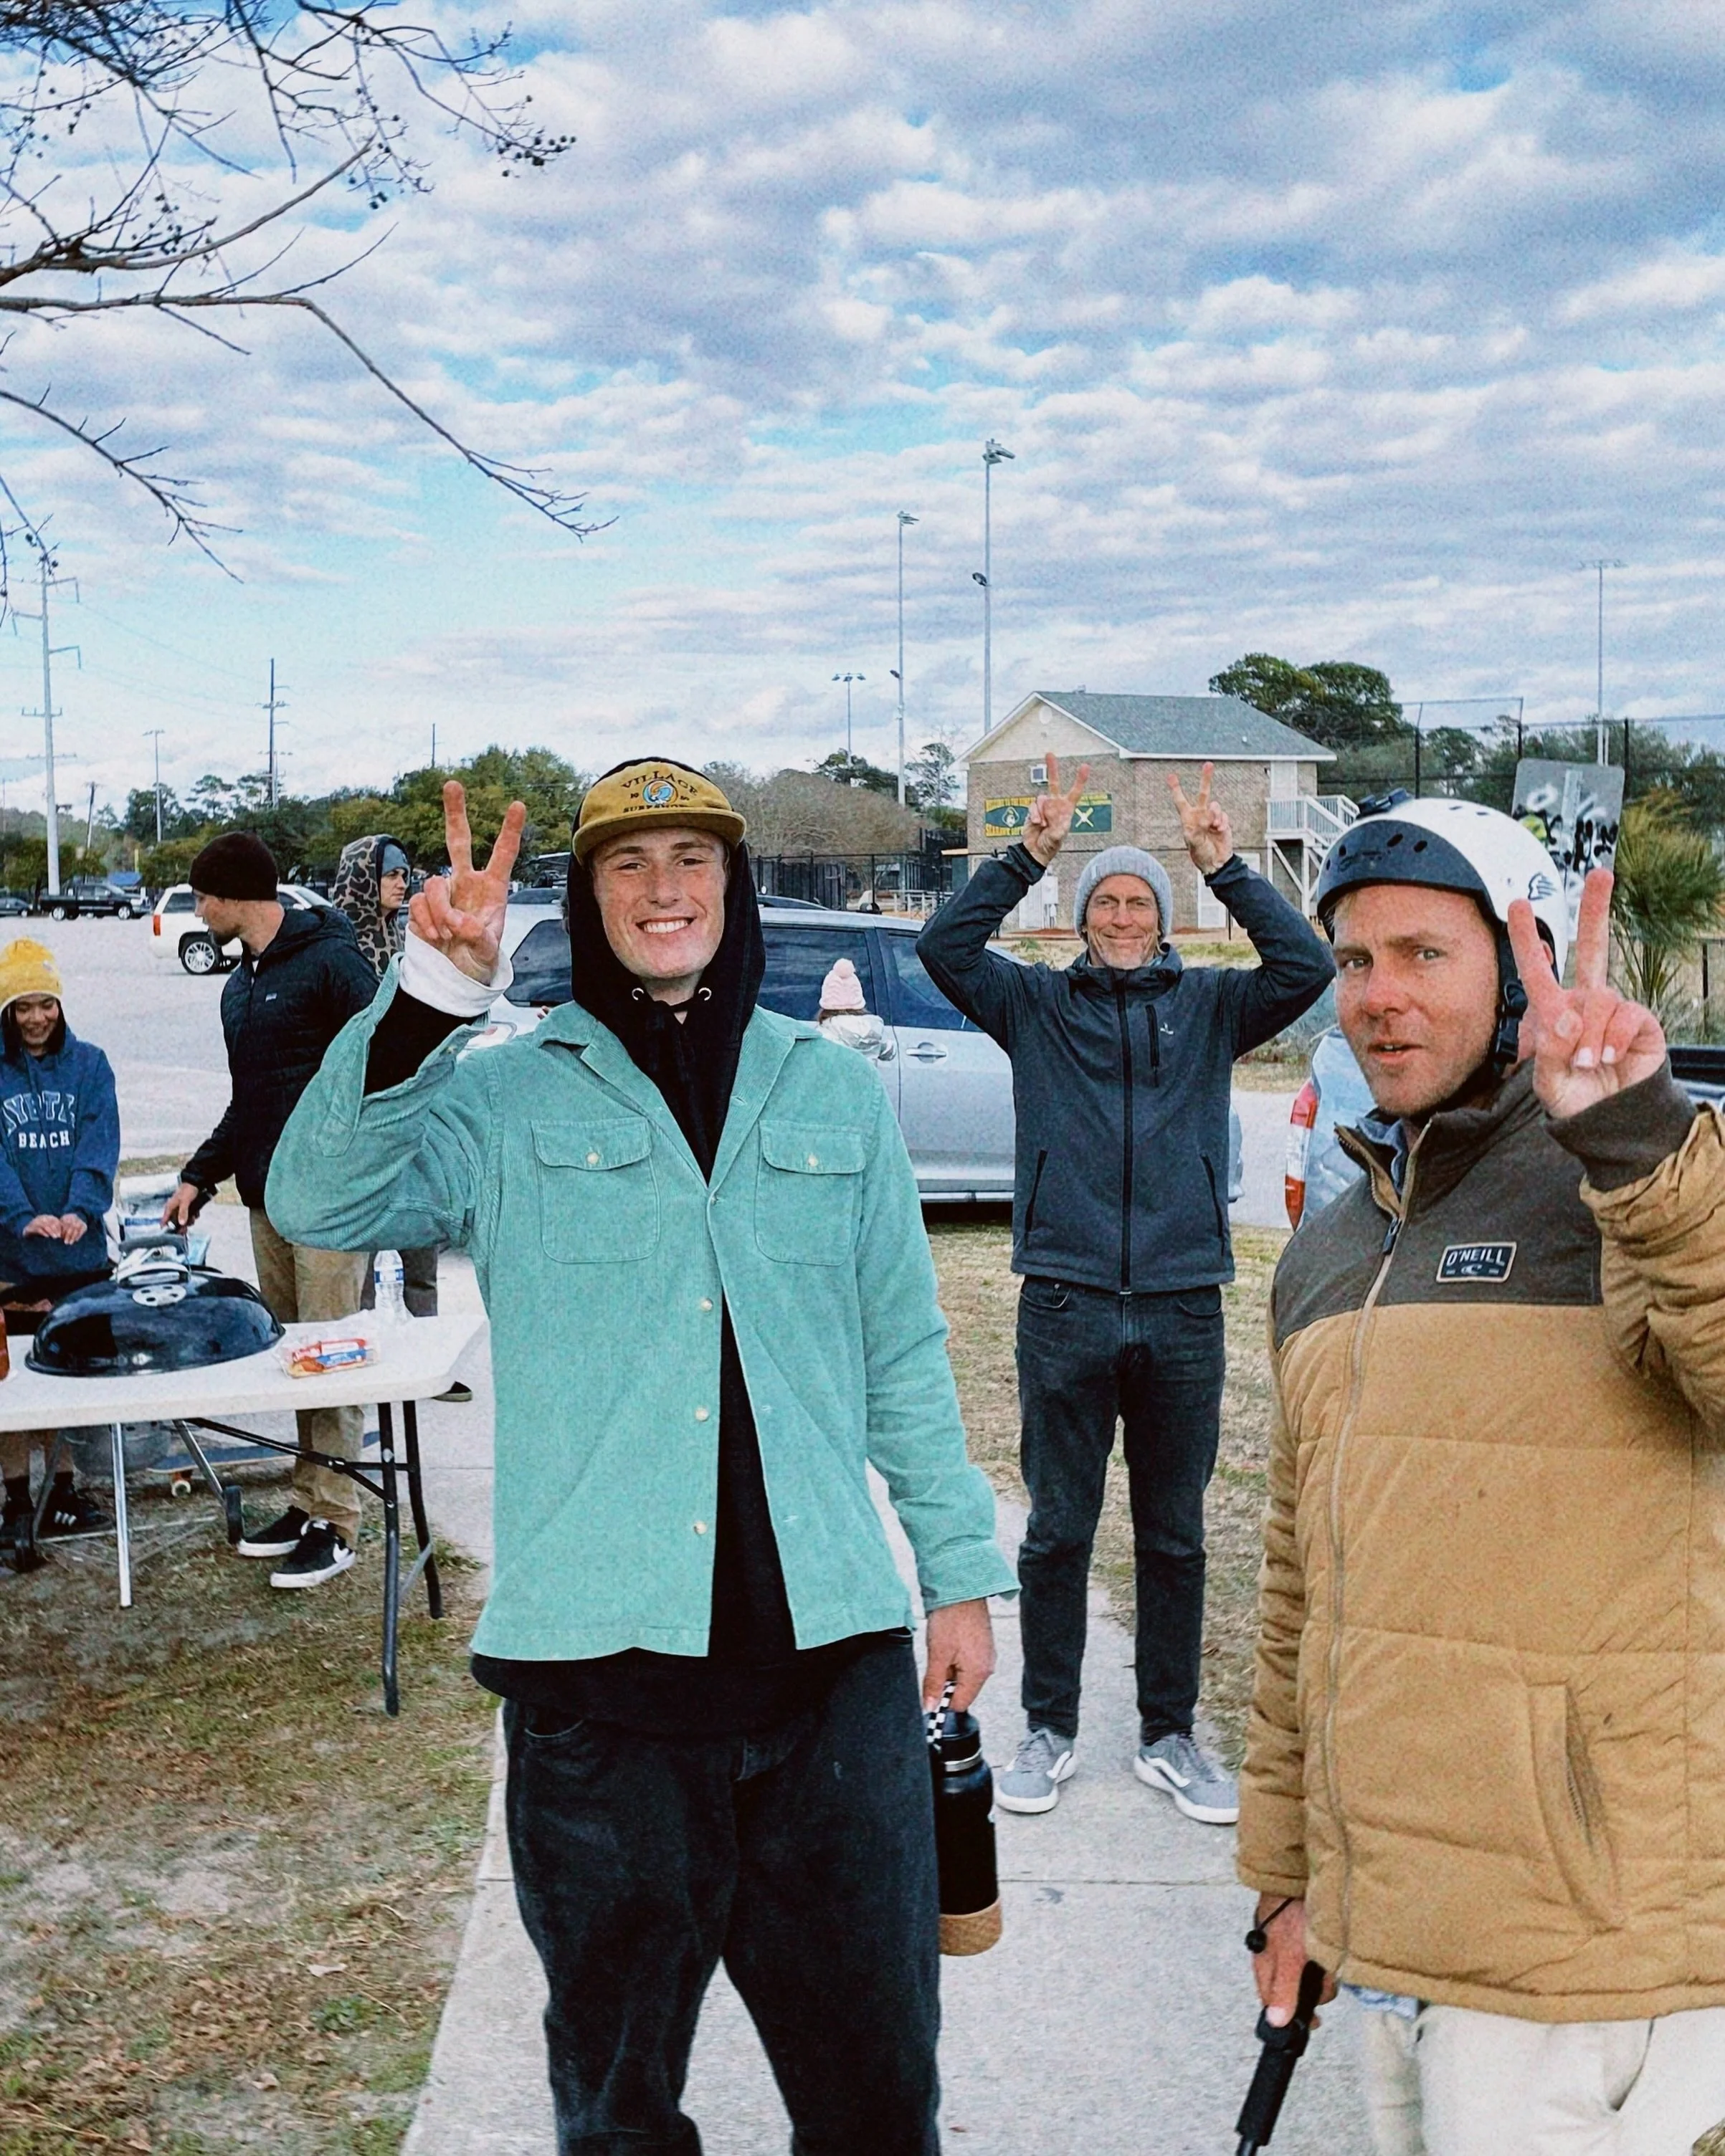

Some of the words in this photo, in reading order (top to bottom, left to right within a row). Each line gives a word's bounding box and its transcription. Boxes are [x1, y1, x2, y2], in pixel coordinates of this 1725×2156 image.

[621, 771, 698, 796] VILLAGE
[18, 1130, 70, 1149] BEACH
[1445, 1248, 1506, 1267] O'NEILL
